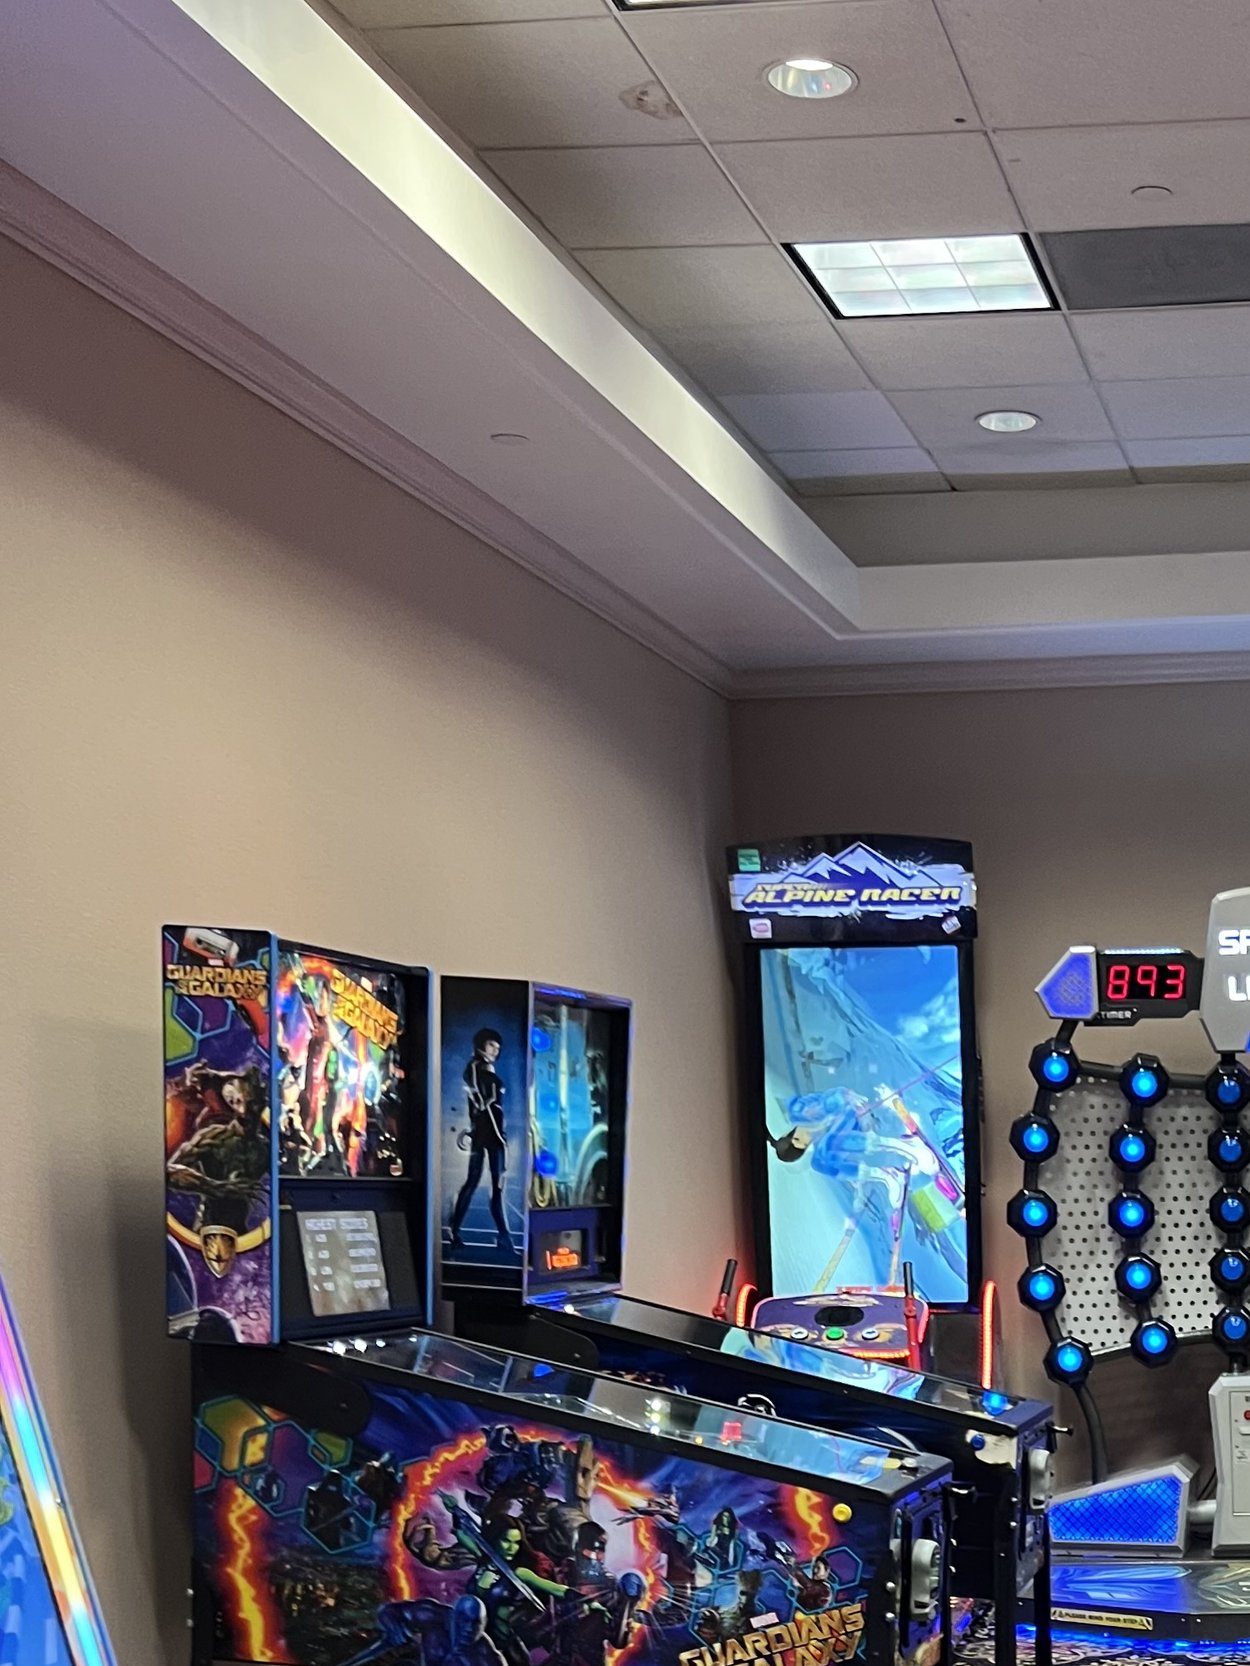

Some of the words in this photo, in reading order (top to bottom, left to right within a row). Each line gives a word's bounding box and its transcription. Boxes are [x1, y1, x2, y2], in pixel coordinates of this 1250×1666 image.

[744, 889, 856, 903] ALPINE
[860, 887, 960, 901] RACER
[167, 964, 267, 985] GUARDIANS
[1107, 965, 1185, 999] 893
[189, 980, 262, 999] GALAXY
[1101, 1011, 1131, 1019] TIMER
